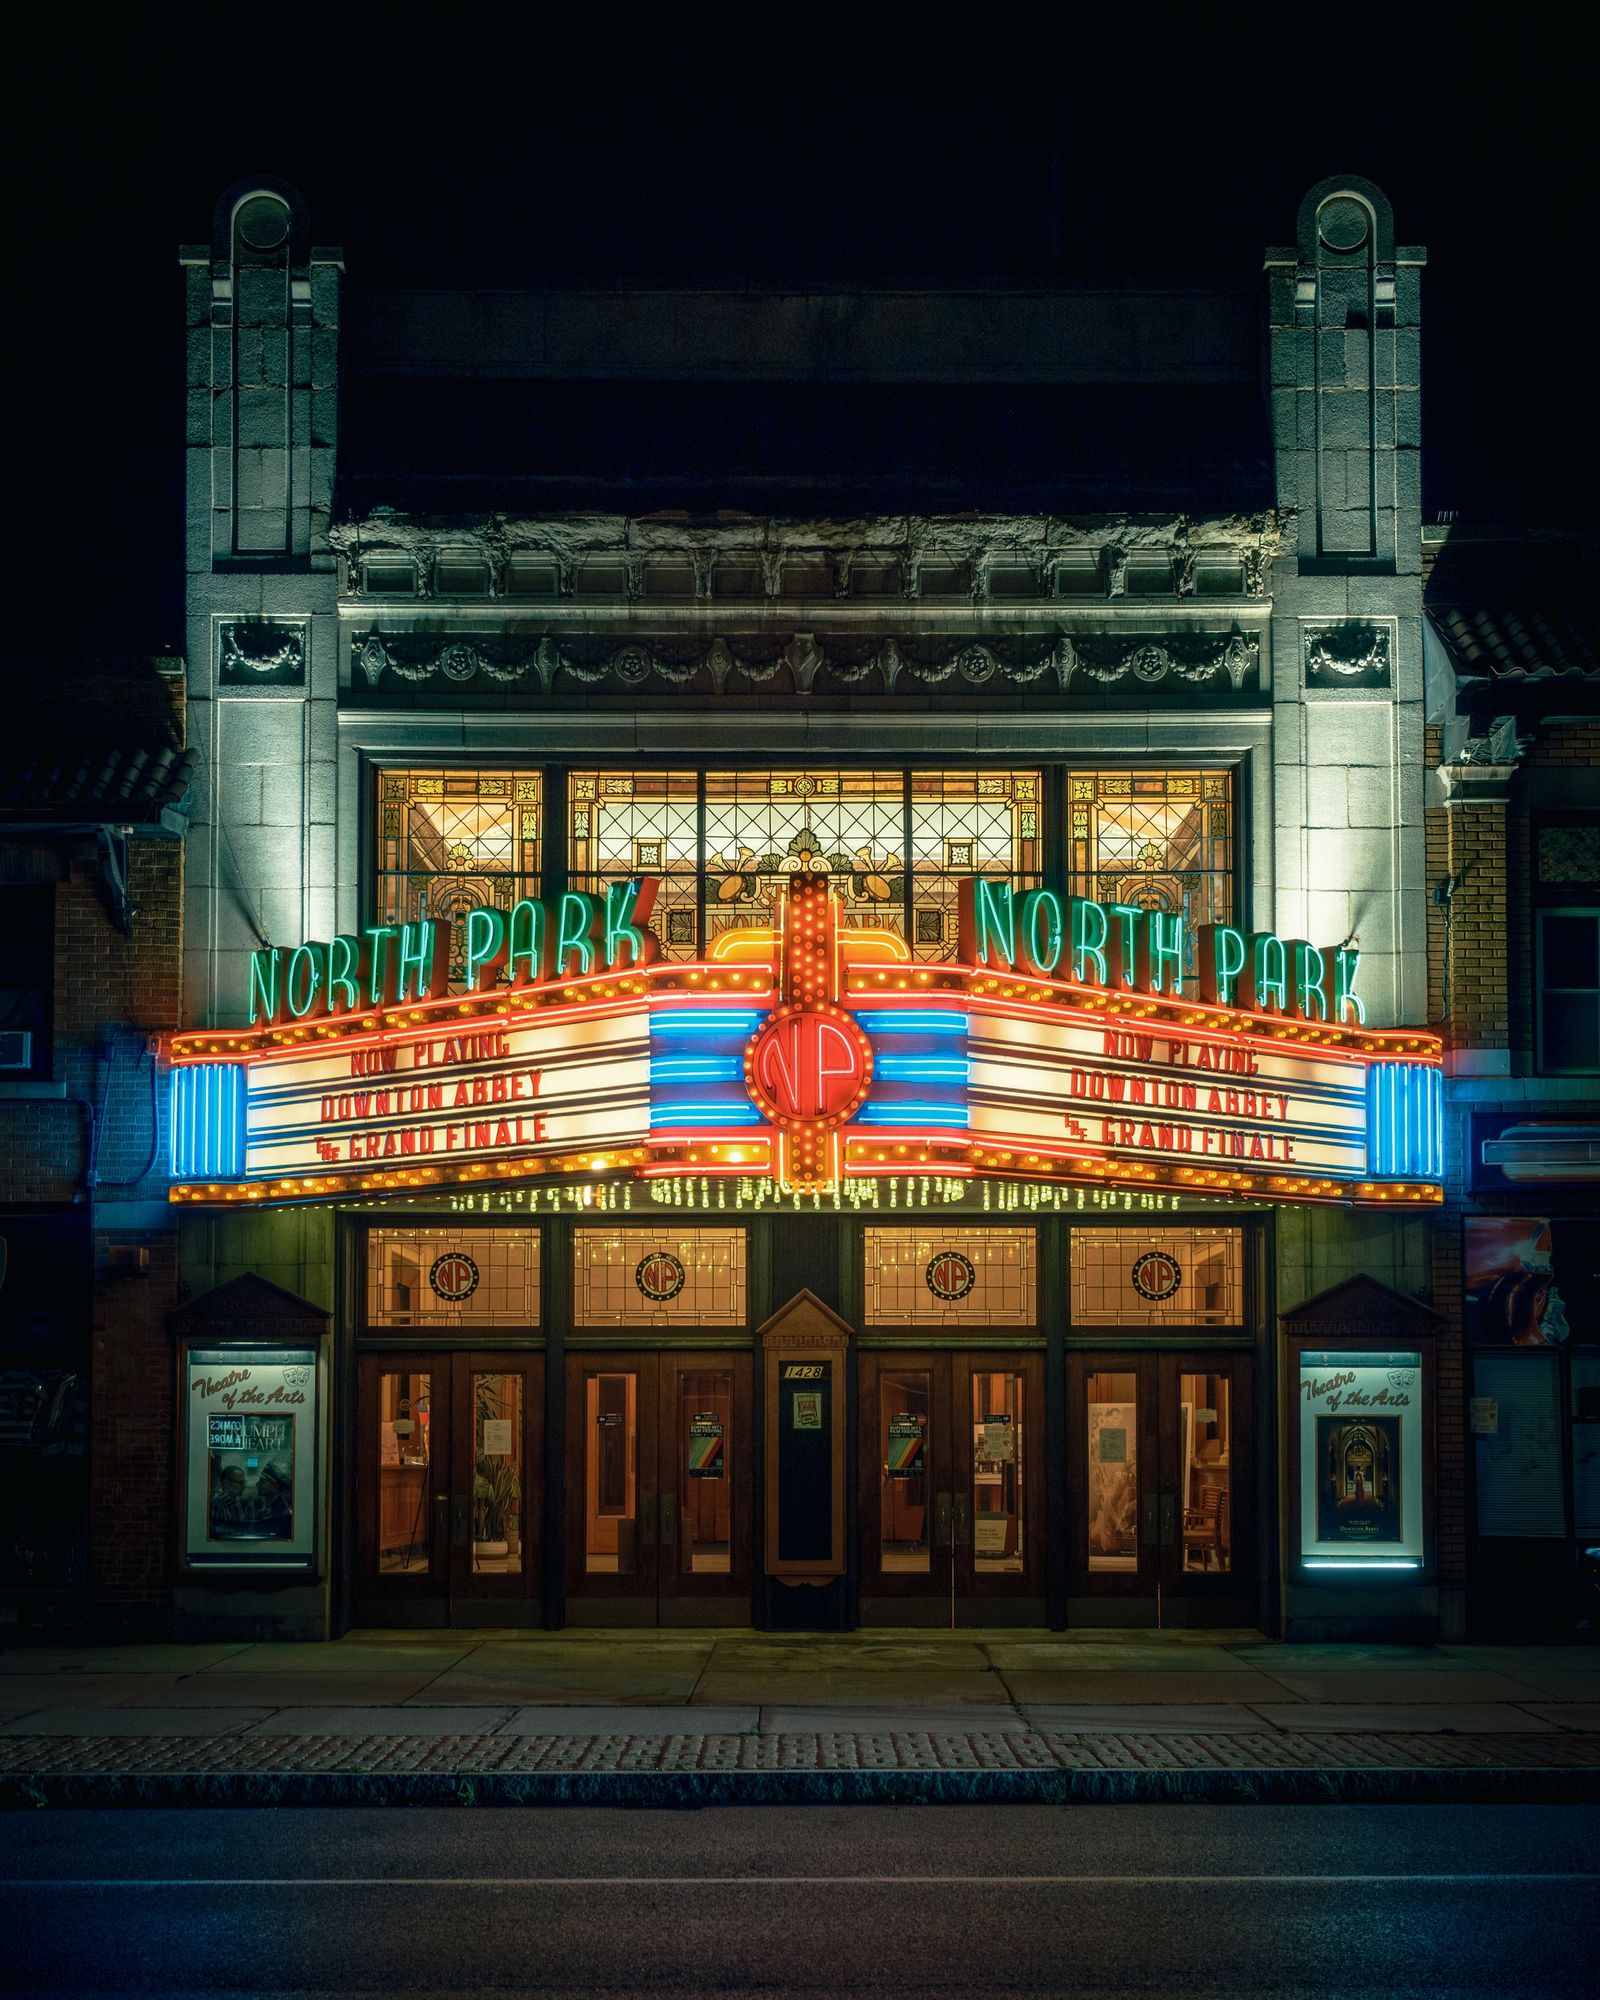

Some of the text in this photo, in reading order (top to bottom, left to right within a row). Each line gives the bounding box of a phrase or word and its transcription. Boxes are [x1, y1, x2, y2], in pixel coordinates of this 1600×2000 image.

[249, 878, 658, 1024] NORTH PARK
[974, 877, 1366, 1026] NORTH PARK
[350, 1030, 510, 1077] NOW PLAYING
[762, 1018, 858, 1115] NP
[1103, 1029, 1259, 1076] NOW PLAYING
[321, 1069, 544, 1122] DOWNTON ABBEY
[1070, 1068, 1291, 1123] DOWNTON ABBEY
[314, 1112, 550, 1162] THE GRAND FINALE
[1063, 1113, 1297, 1164] THE GRAND FINALE
[438, 1264, 471, 1291] NP
[646, 1262, 677, 1291] NP
[934, 1261, 966, 1290] NP
[1141, 1261, 1173, 1290] NP
[192, 1369, 251, 1399] Theatre
[788, 1367, 821, 1378] 1428
[1301, 1371, 1356, 1400] Theatre
[222, 1385, 306, 1410] of the Arts
[1326, 1388, 1410, 1412] of the Arts
